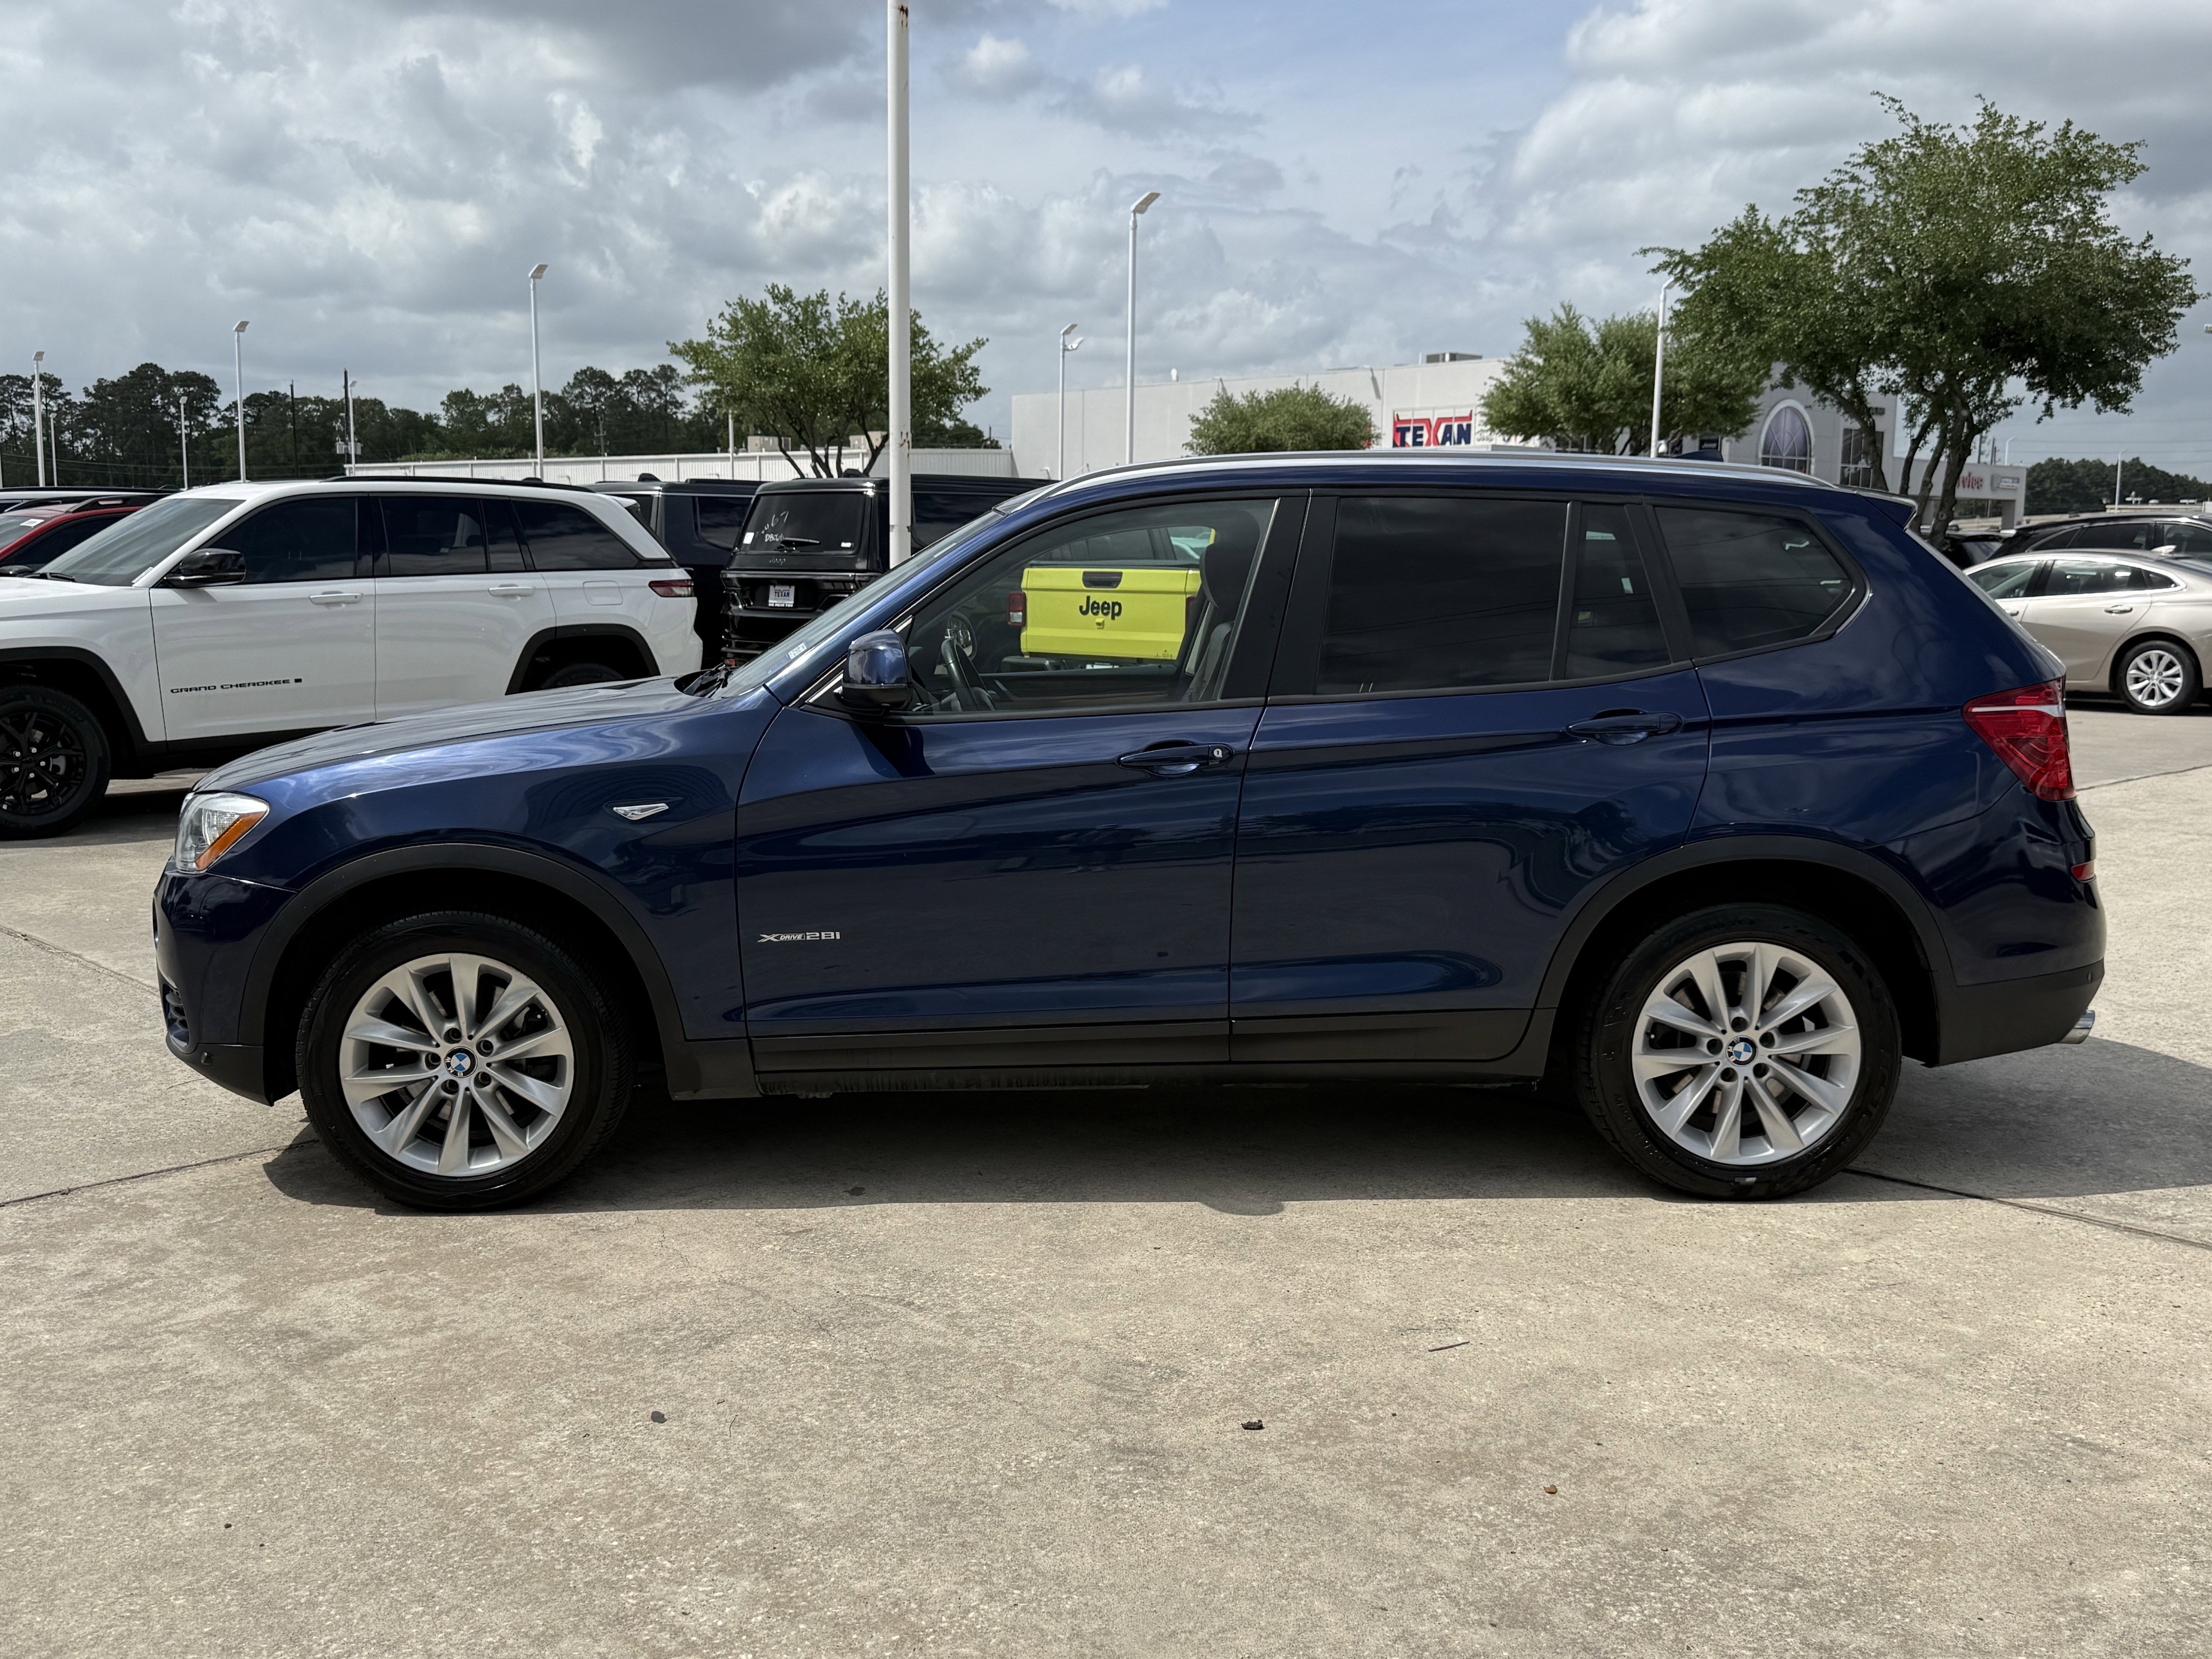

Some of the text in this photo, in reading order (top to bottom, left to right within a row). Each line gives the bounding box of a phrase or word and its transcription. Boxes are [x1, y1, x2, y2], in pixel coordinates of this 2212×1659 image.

[1393, 413, 1472, 448] TEXAN
[1079, 595, 1122, 620] Jeep
[170, 679, 290, 694] GRAND CHEROKEE
